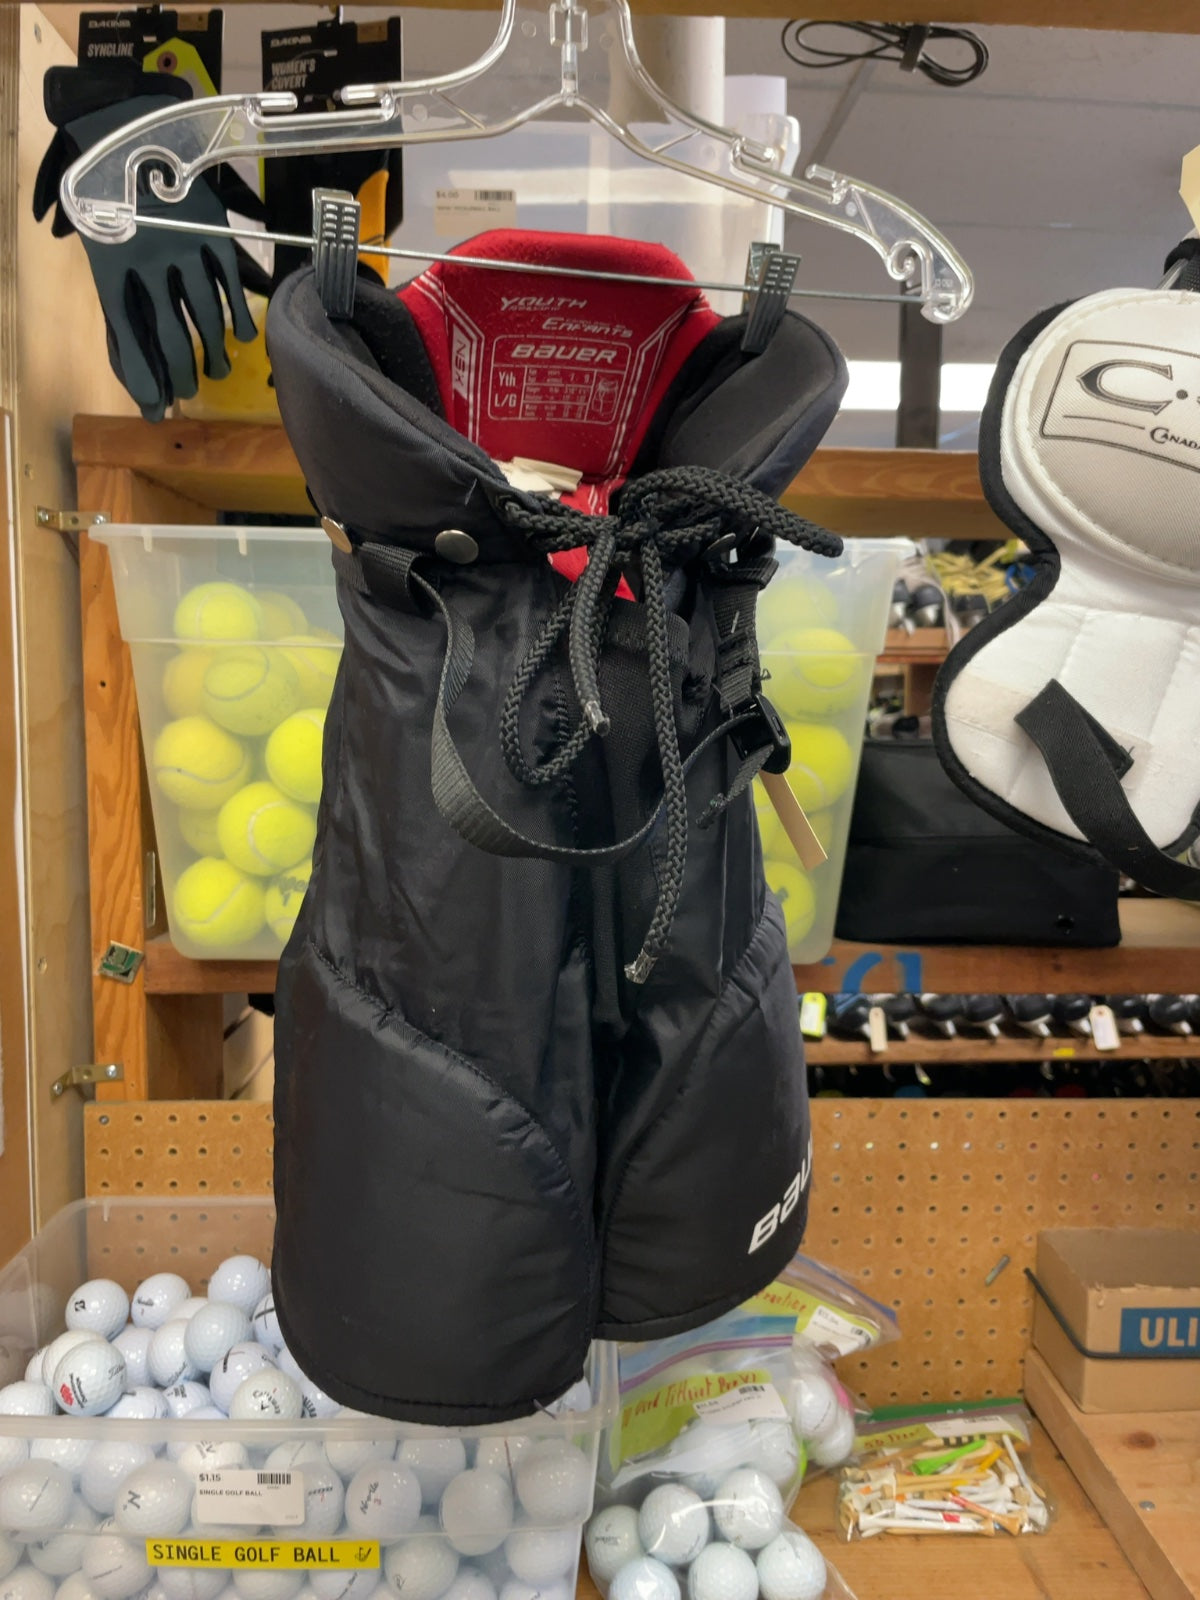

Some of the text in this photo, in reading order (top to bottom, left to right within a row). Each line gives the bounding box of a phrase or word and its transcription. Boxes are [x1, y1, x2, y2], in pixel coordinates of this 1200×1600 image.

[87, 42, 134, 57] SYNCLINE
[271, 59, 316, 76] WOMEN'S
[271, 74, 307, 90] COVERT
[500, 296, 587, 311] YOUTH
[511, 343, 617, 364] BAUER
[499, 371, 516, 387] Yth
[494, 393, 517, 407] L/G
[1150, 427, 1200, 450] CANAD
[1139, 1317, 1199, 1348] ULI
[199, 1473, 222, 1482] $1.15
[225, 1489, 243, 1497] GOLF
[152, 1544, 341, 1563] SINGLE GOLF BALL
